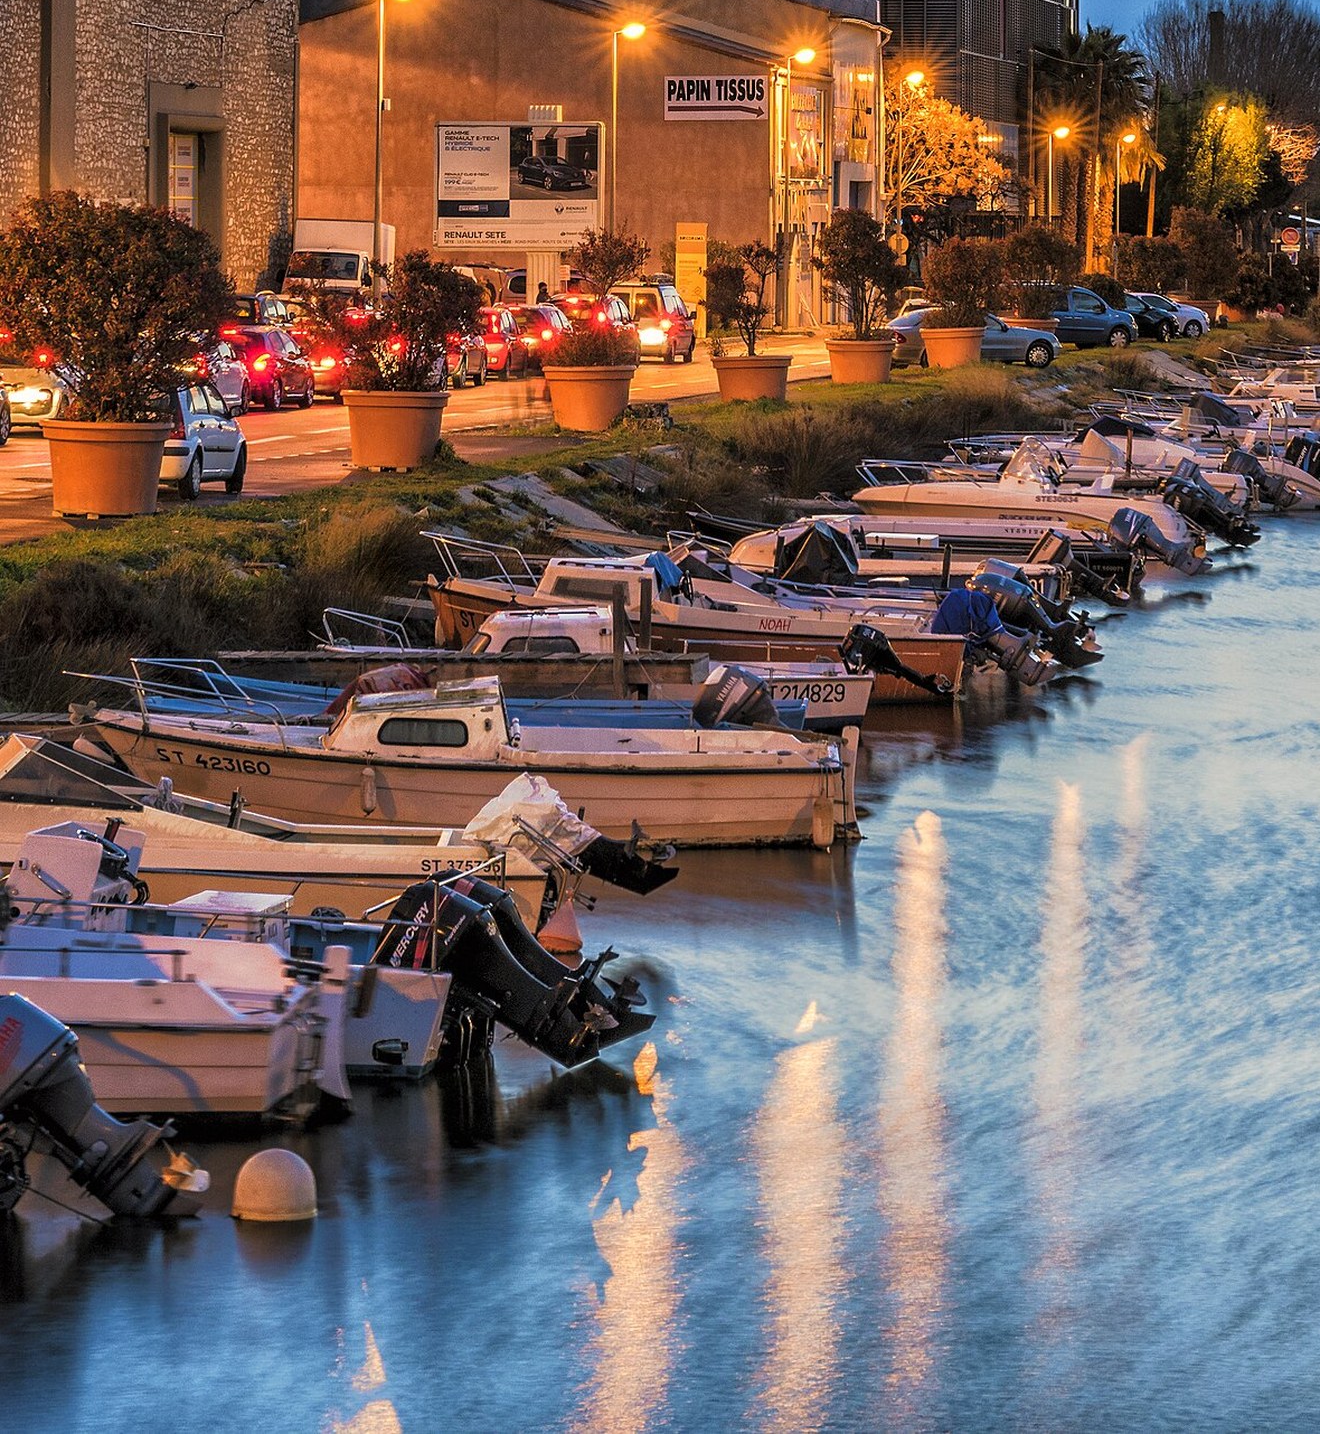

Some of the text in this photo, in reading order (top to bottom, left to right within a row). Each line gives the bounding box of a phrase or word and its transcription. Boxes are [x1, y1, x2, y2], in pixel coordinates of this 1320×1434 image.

[668, 79, 765, 101] PAPIN TISSUS
[444, 231, 483, 239] RENAULT
[485, 231, 507, 239] SETE
[460, 611, 476, 630] ST
[758, 619, 792, 632] NOAH
[716, 676, 738, 703] YAMAHA
[156, 748, 271, 776] ST 423160
[421, 859, 441, 872] ST
[389, 901, 430, 967] MERCURY
